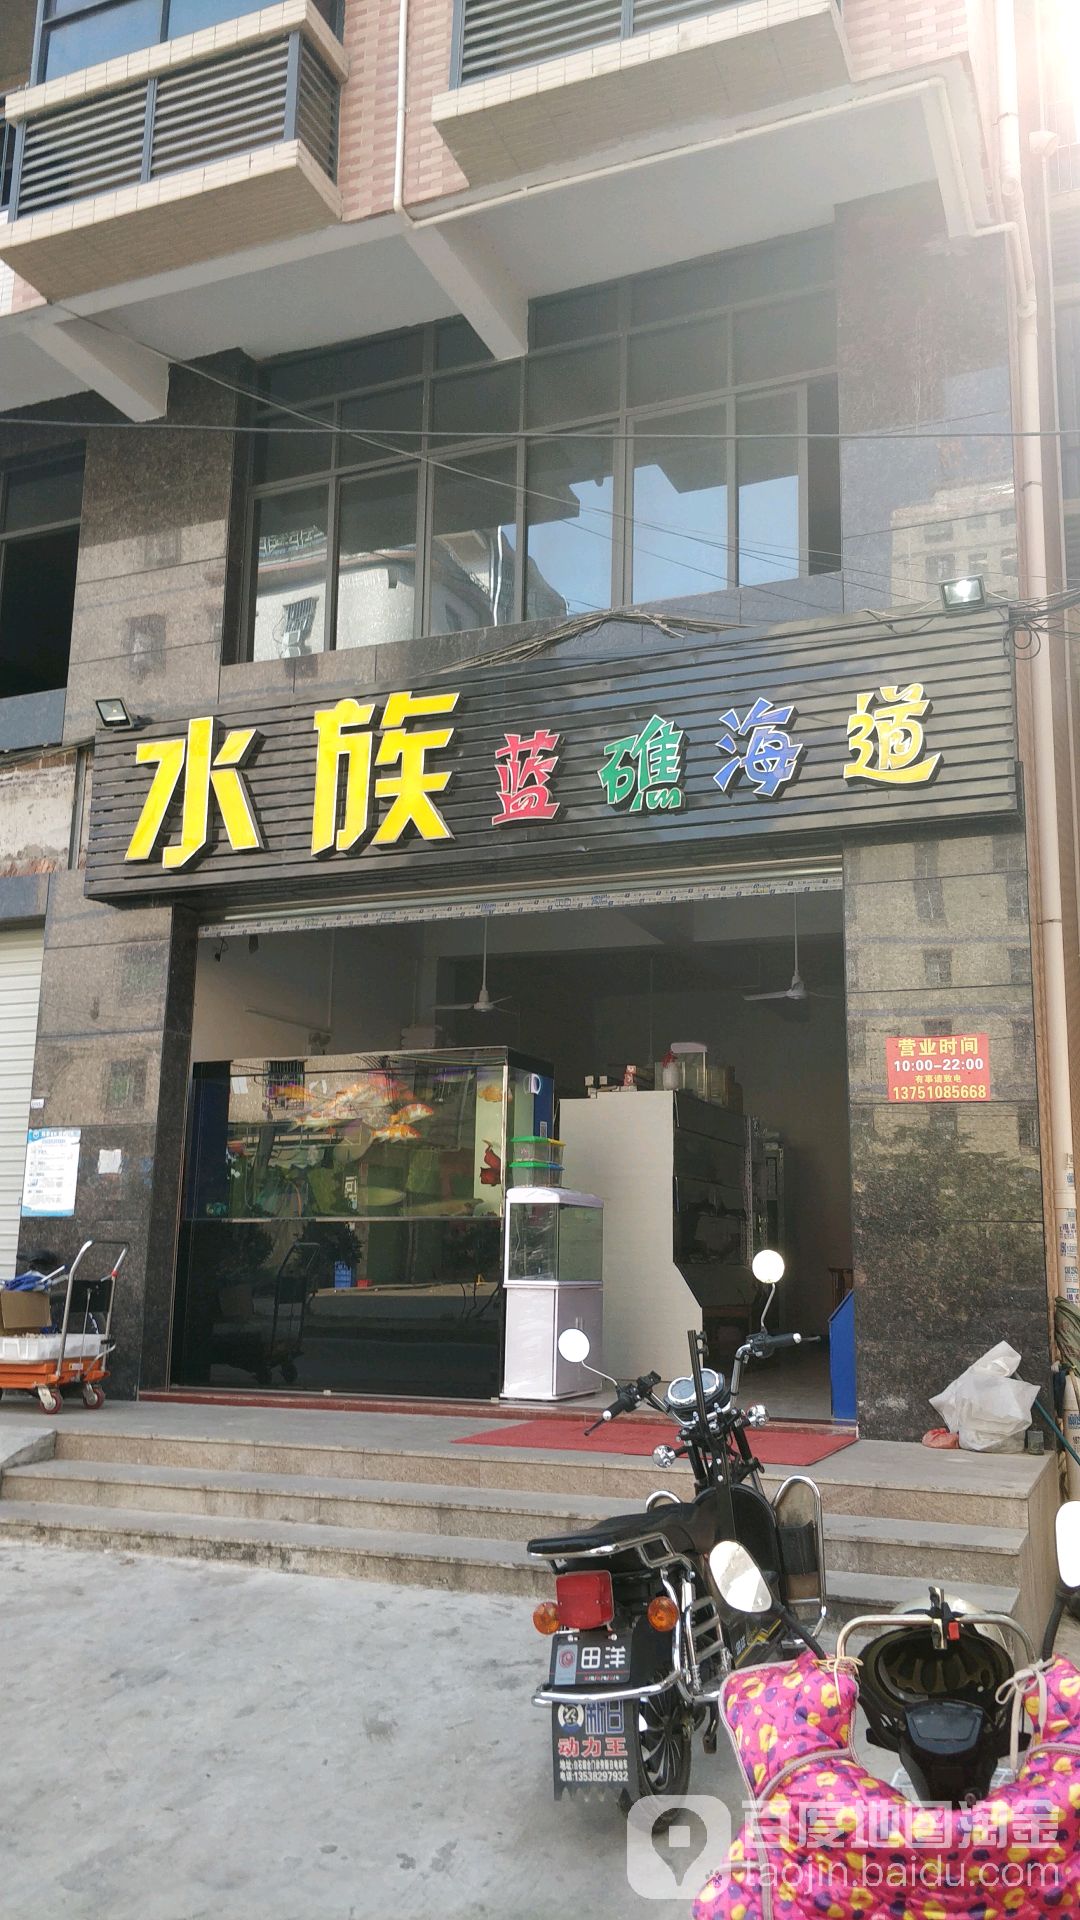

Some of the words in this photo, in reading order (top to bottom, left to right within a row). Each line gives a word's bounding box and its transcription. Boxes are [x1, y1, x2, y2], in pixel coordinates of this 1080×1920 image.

[124, 690, 461, 871] 水族
[491, 683, 941, 828] 蓝礁海道
[898, 1036, 978, 1057] 营业时间
[893, 1058, 984, 1072] 10:00-22:00
[914, 1074, 962, 1084] 有事请致电
[893, 1084, 987, 1100] 13751085668
[581, 1646, 626, 1669] 田洋
[558, 1737, 628, 1758] 动力王
